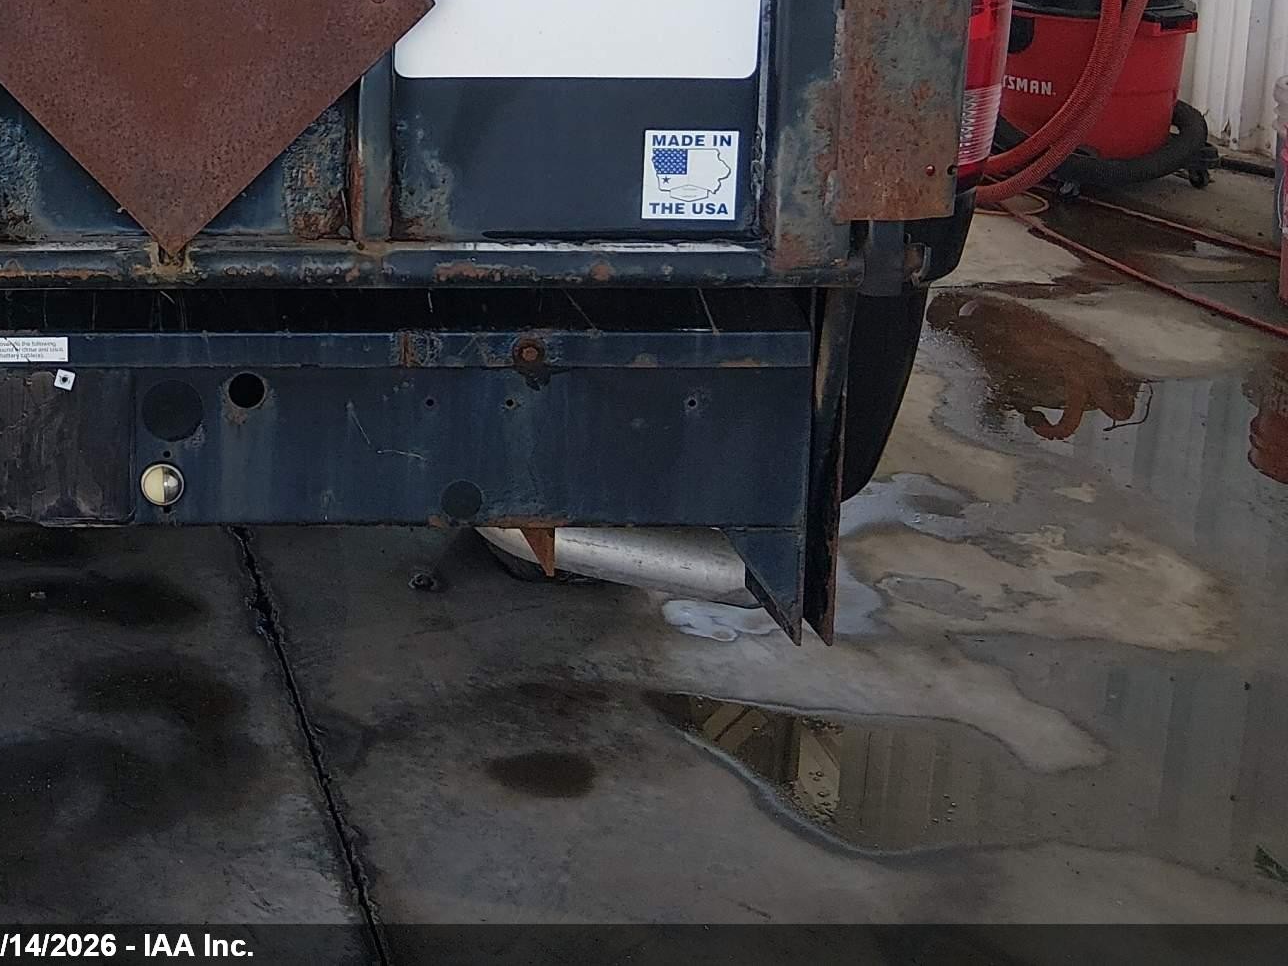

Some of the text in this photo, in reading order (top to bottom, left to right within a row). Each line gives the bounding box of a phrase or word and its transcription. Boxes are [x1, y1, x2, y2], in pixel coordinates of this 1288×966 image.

[1003, 75, 1052, 96] TSMAN
[652, 134, 732, 147] MADE IN
[649, 202, 729, 215] THE USA
